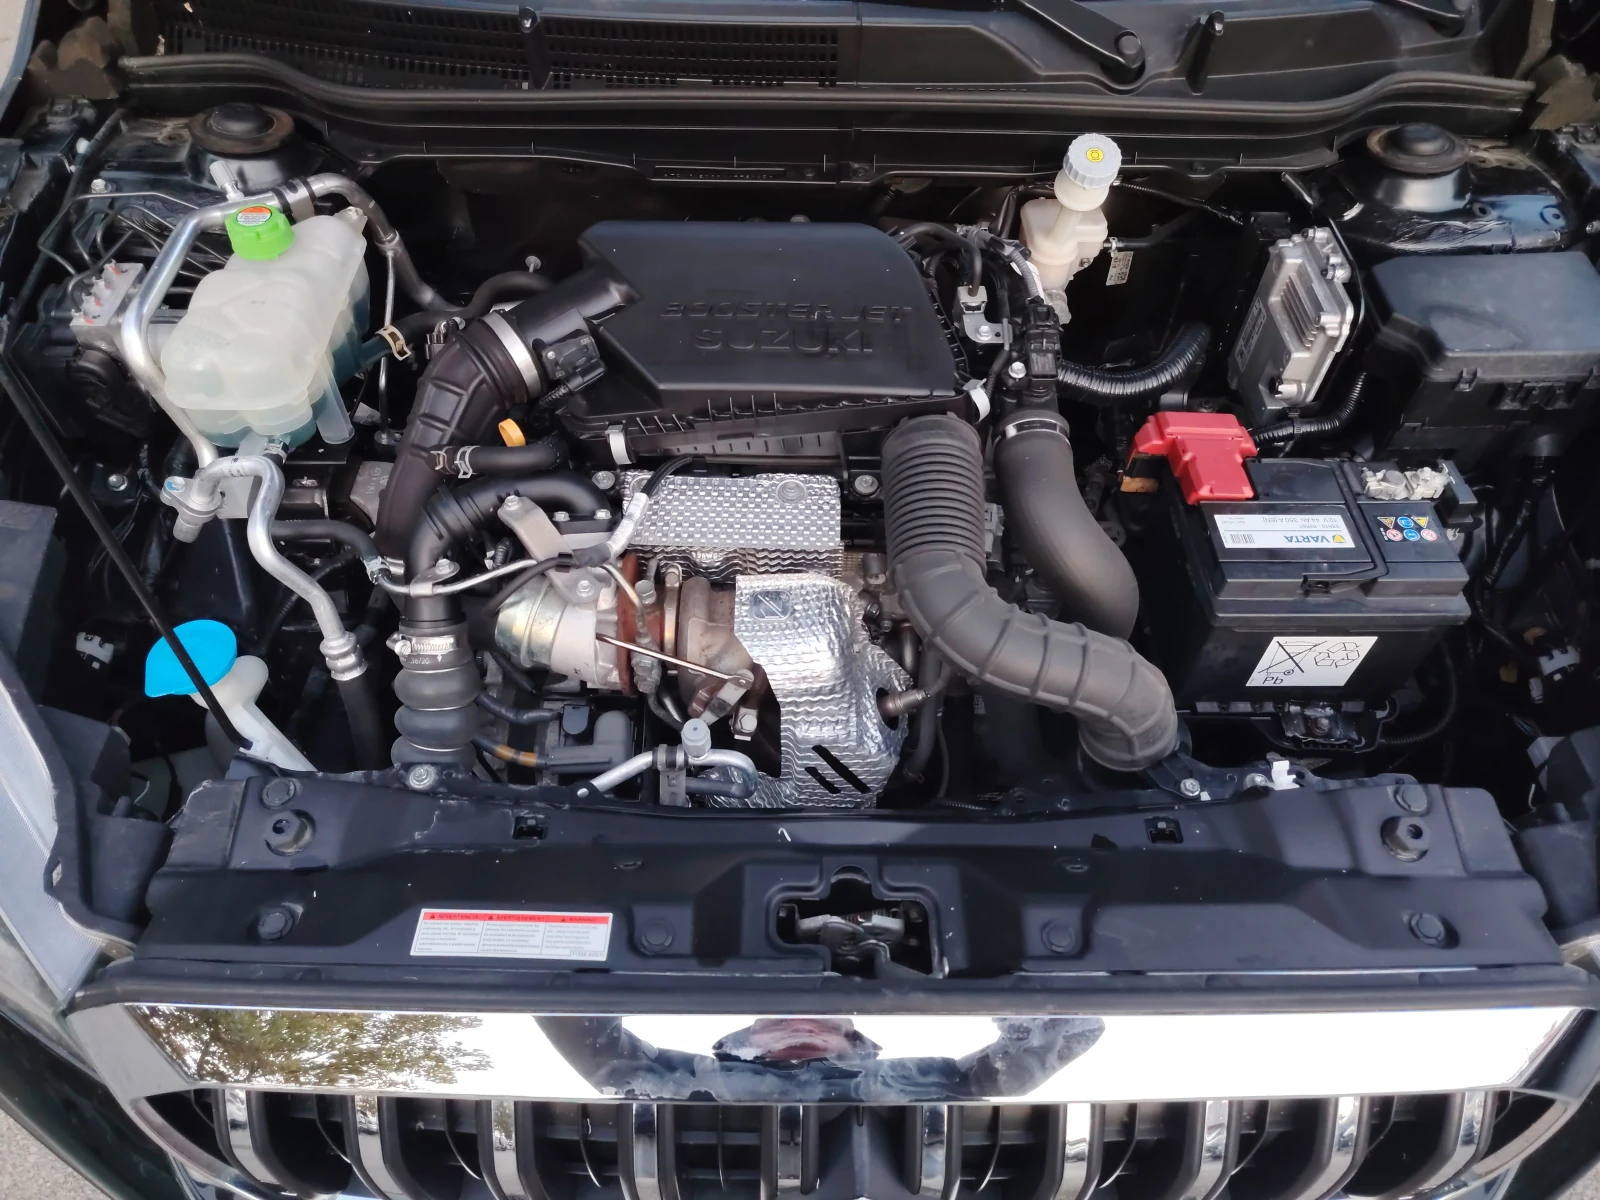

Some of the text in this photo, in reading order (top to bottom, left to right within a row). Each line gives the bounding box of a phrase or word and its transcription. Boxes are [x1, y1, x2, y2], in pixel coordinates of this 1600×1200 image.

[693, 329, 873, 353] SUZUKI
[1283, 535, 1331, 544] VARTA
[1262, 676, 1284, 685] Pb
